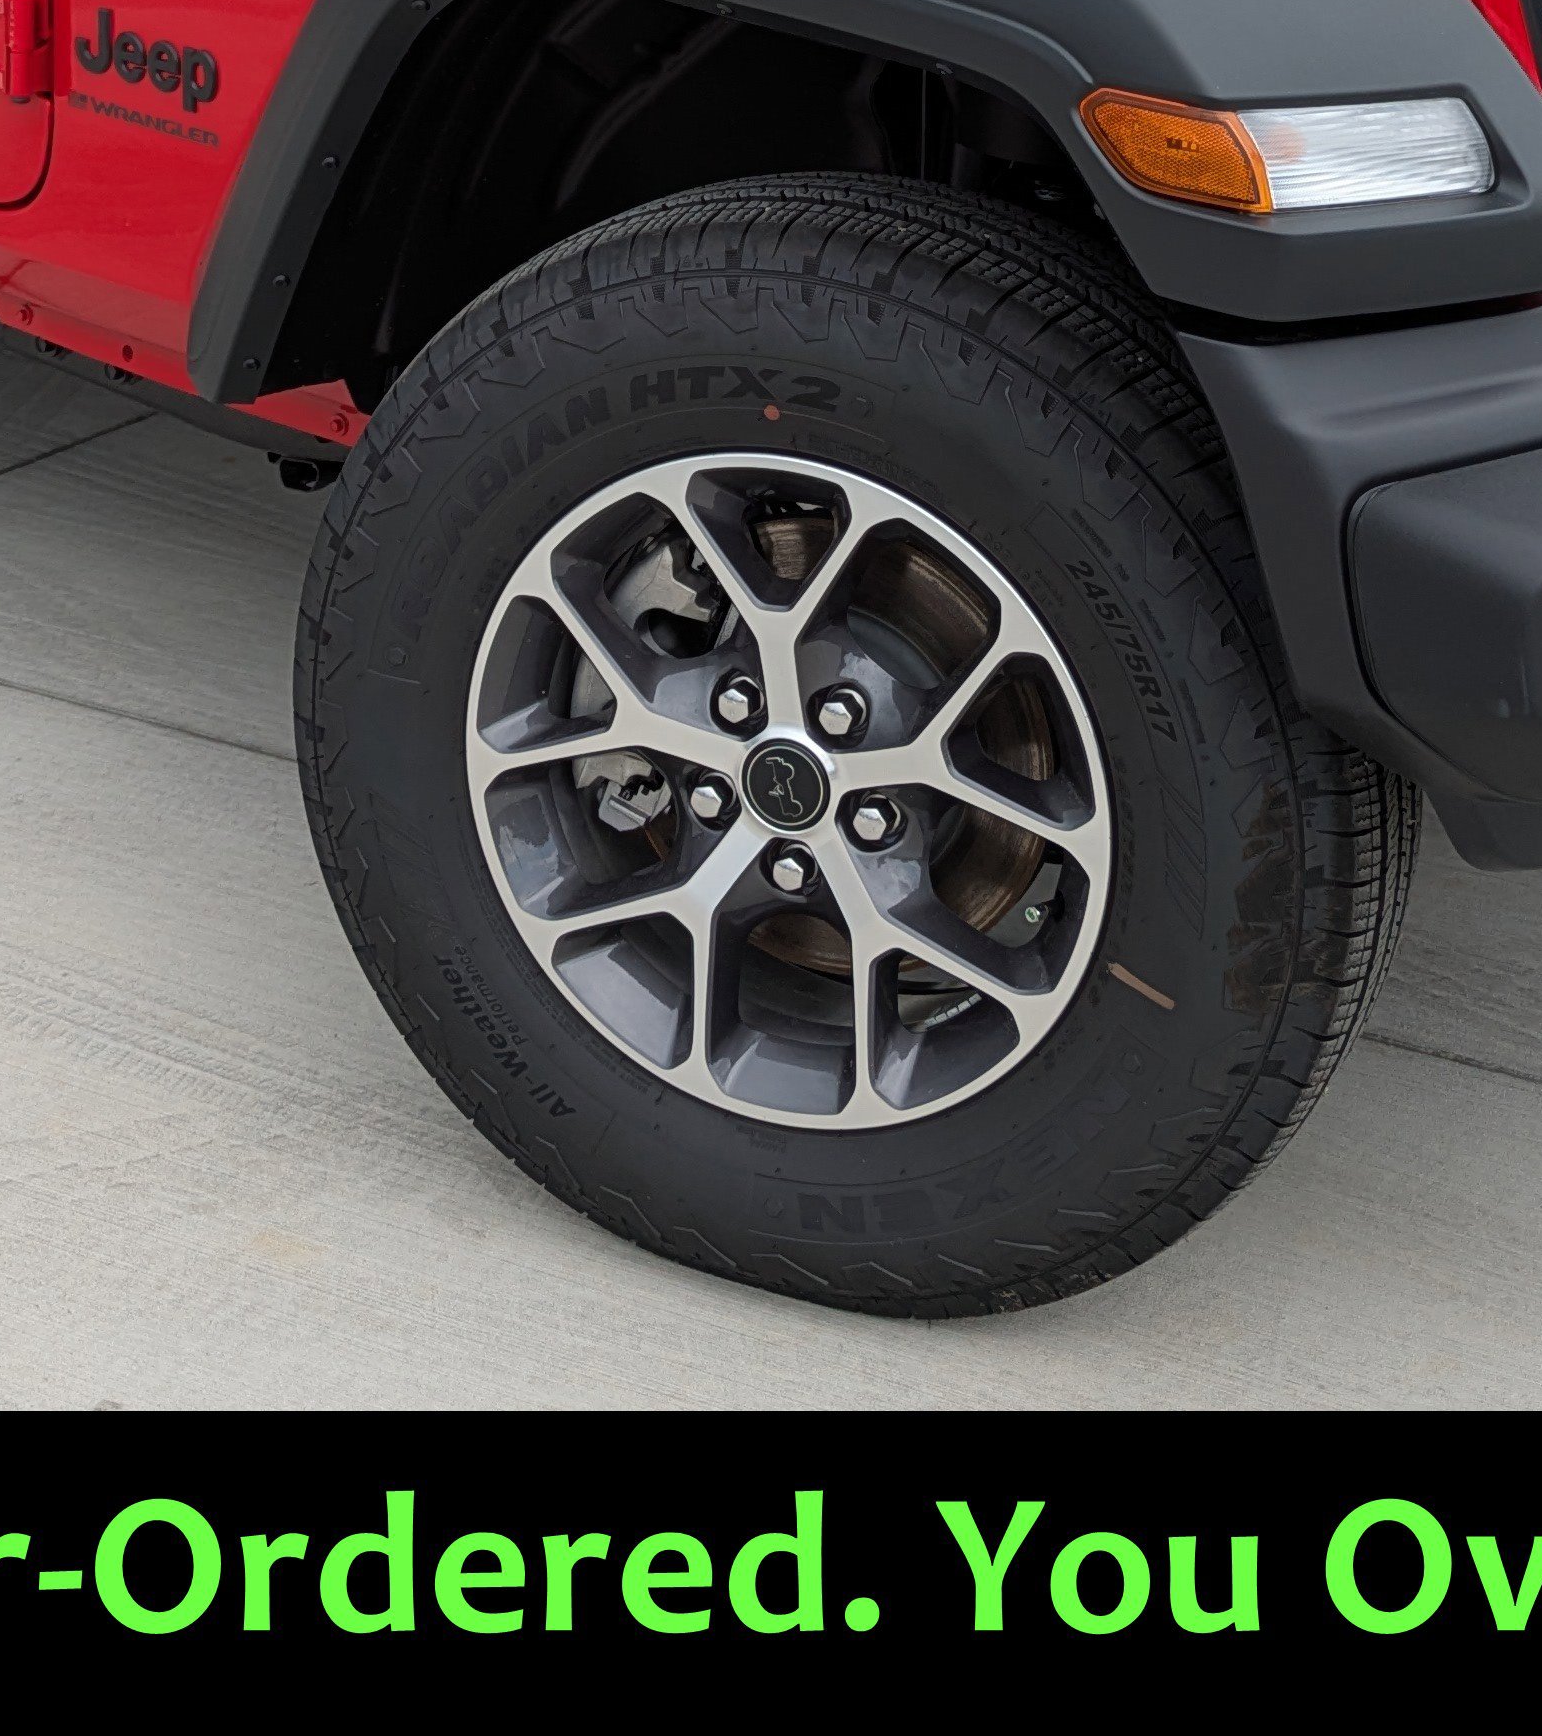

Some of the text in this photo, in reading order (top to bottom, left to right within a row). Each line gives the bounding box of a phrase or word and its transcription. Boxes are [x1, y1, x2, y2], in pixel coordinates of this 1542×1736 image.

[74, 6, 219, 113] Jeep
[90, 96, 219, 147] WRANGLER
[1063, 559, 1178, 743] 245/75R17
[432, 953, 577, 1119] All-Weather
[453, 943, 533, 1048] Performance
